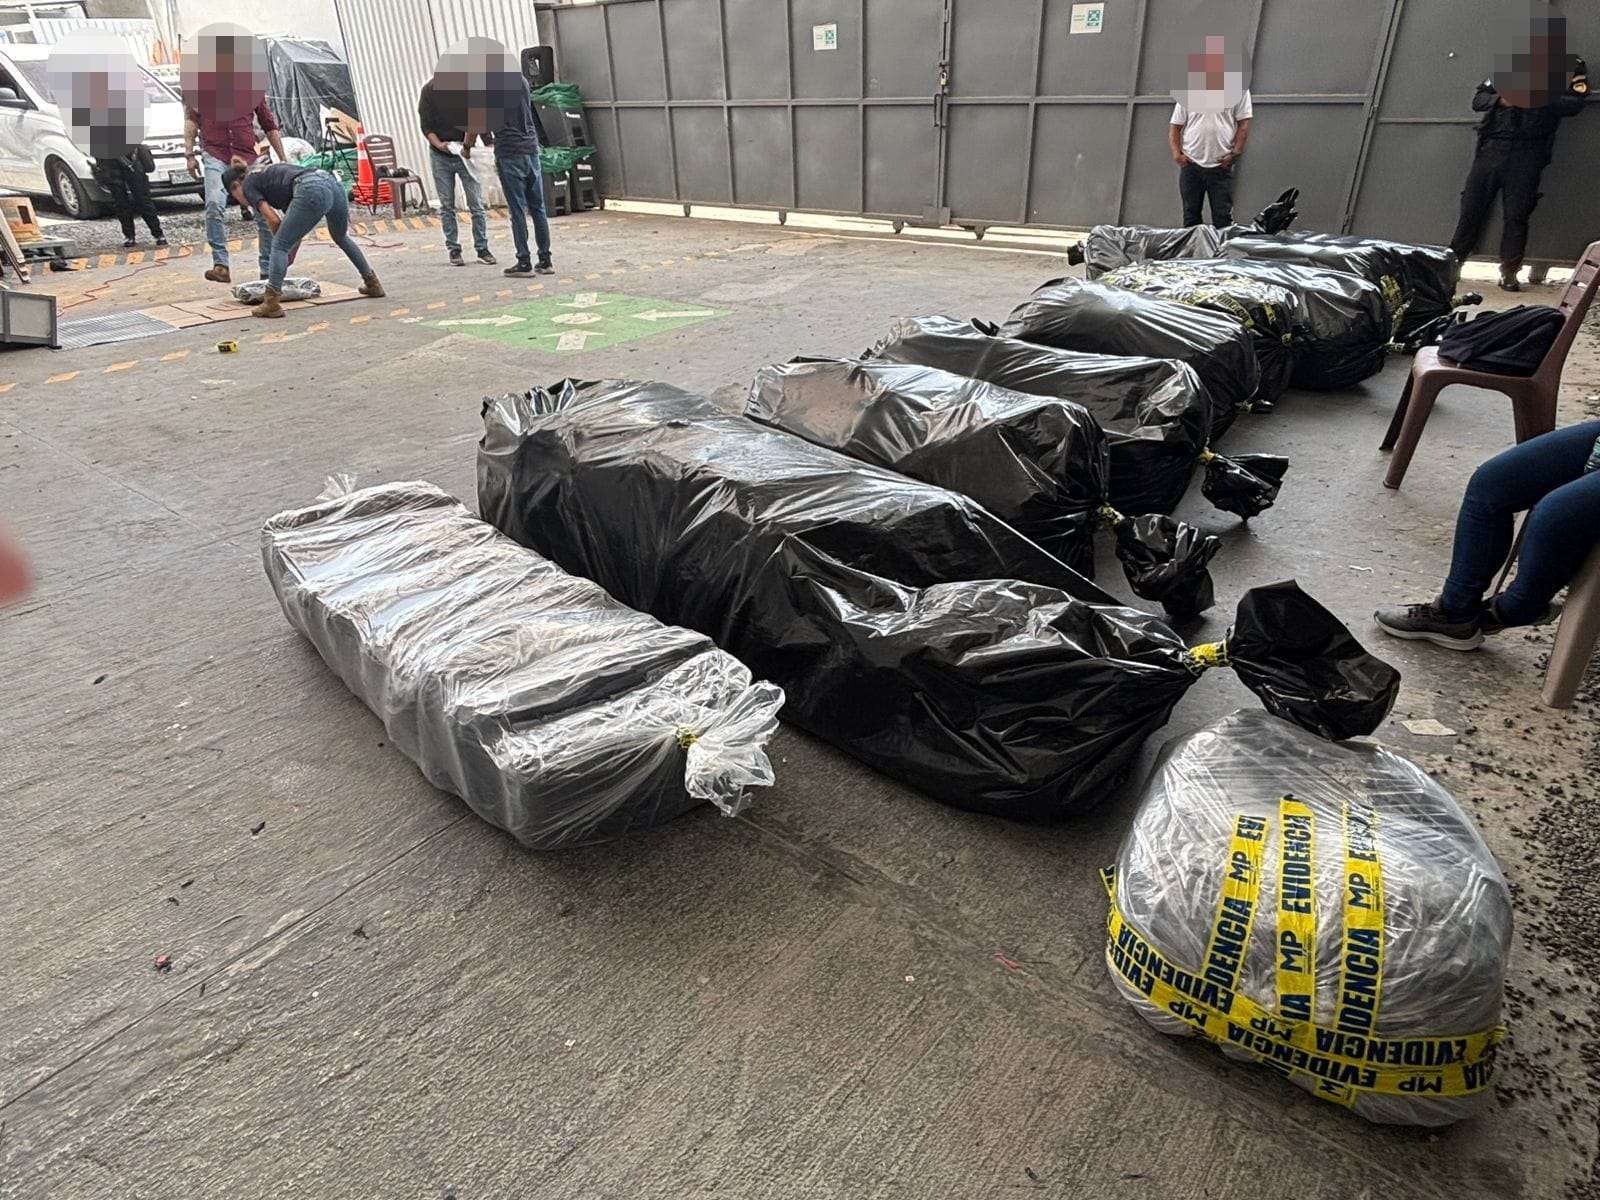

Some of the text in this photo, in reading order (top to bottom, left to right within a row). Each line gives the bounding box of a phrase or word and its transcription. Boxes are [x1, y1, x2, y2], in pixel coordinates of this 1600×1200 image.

[1348, 873, 1371, 909] MP
[1205, 897, 1253, 989] DENCIA
[1229, 851, 1249, 883] MP
[1117, 922, 1234, 1014] EVIDENCIA
[1280, 930, 1303, 972] MP
[1337, 928, 1380, 1036] IDENCIA
[1168, 1001, 1208, 1026] MP
[1227, 1022, 1377, 1088] EVIDENCIA
[1316, 1028, 1467, 1066] EVIDENCIA
[1398, 1076, 1442, 1093] MP
